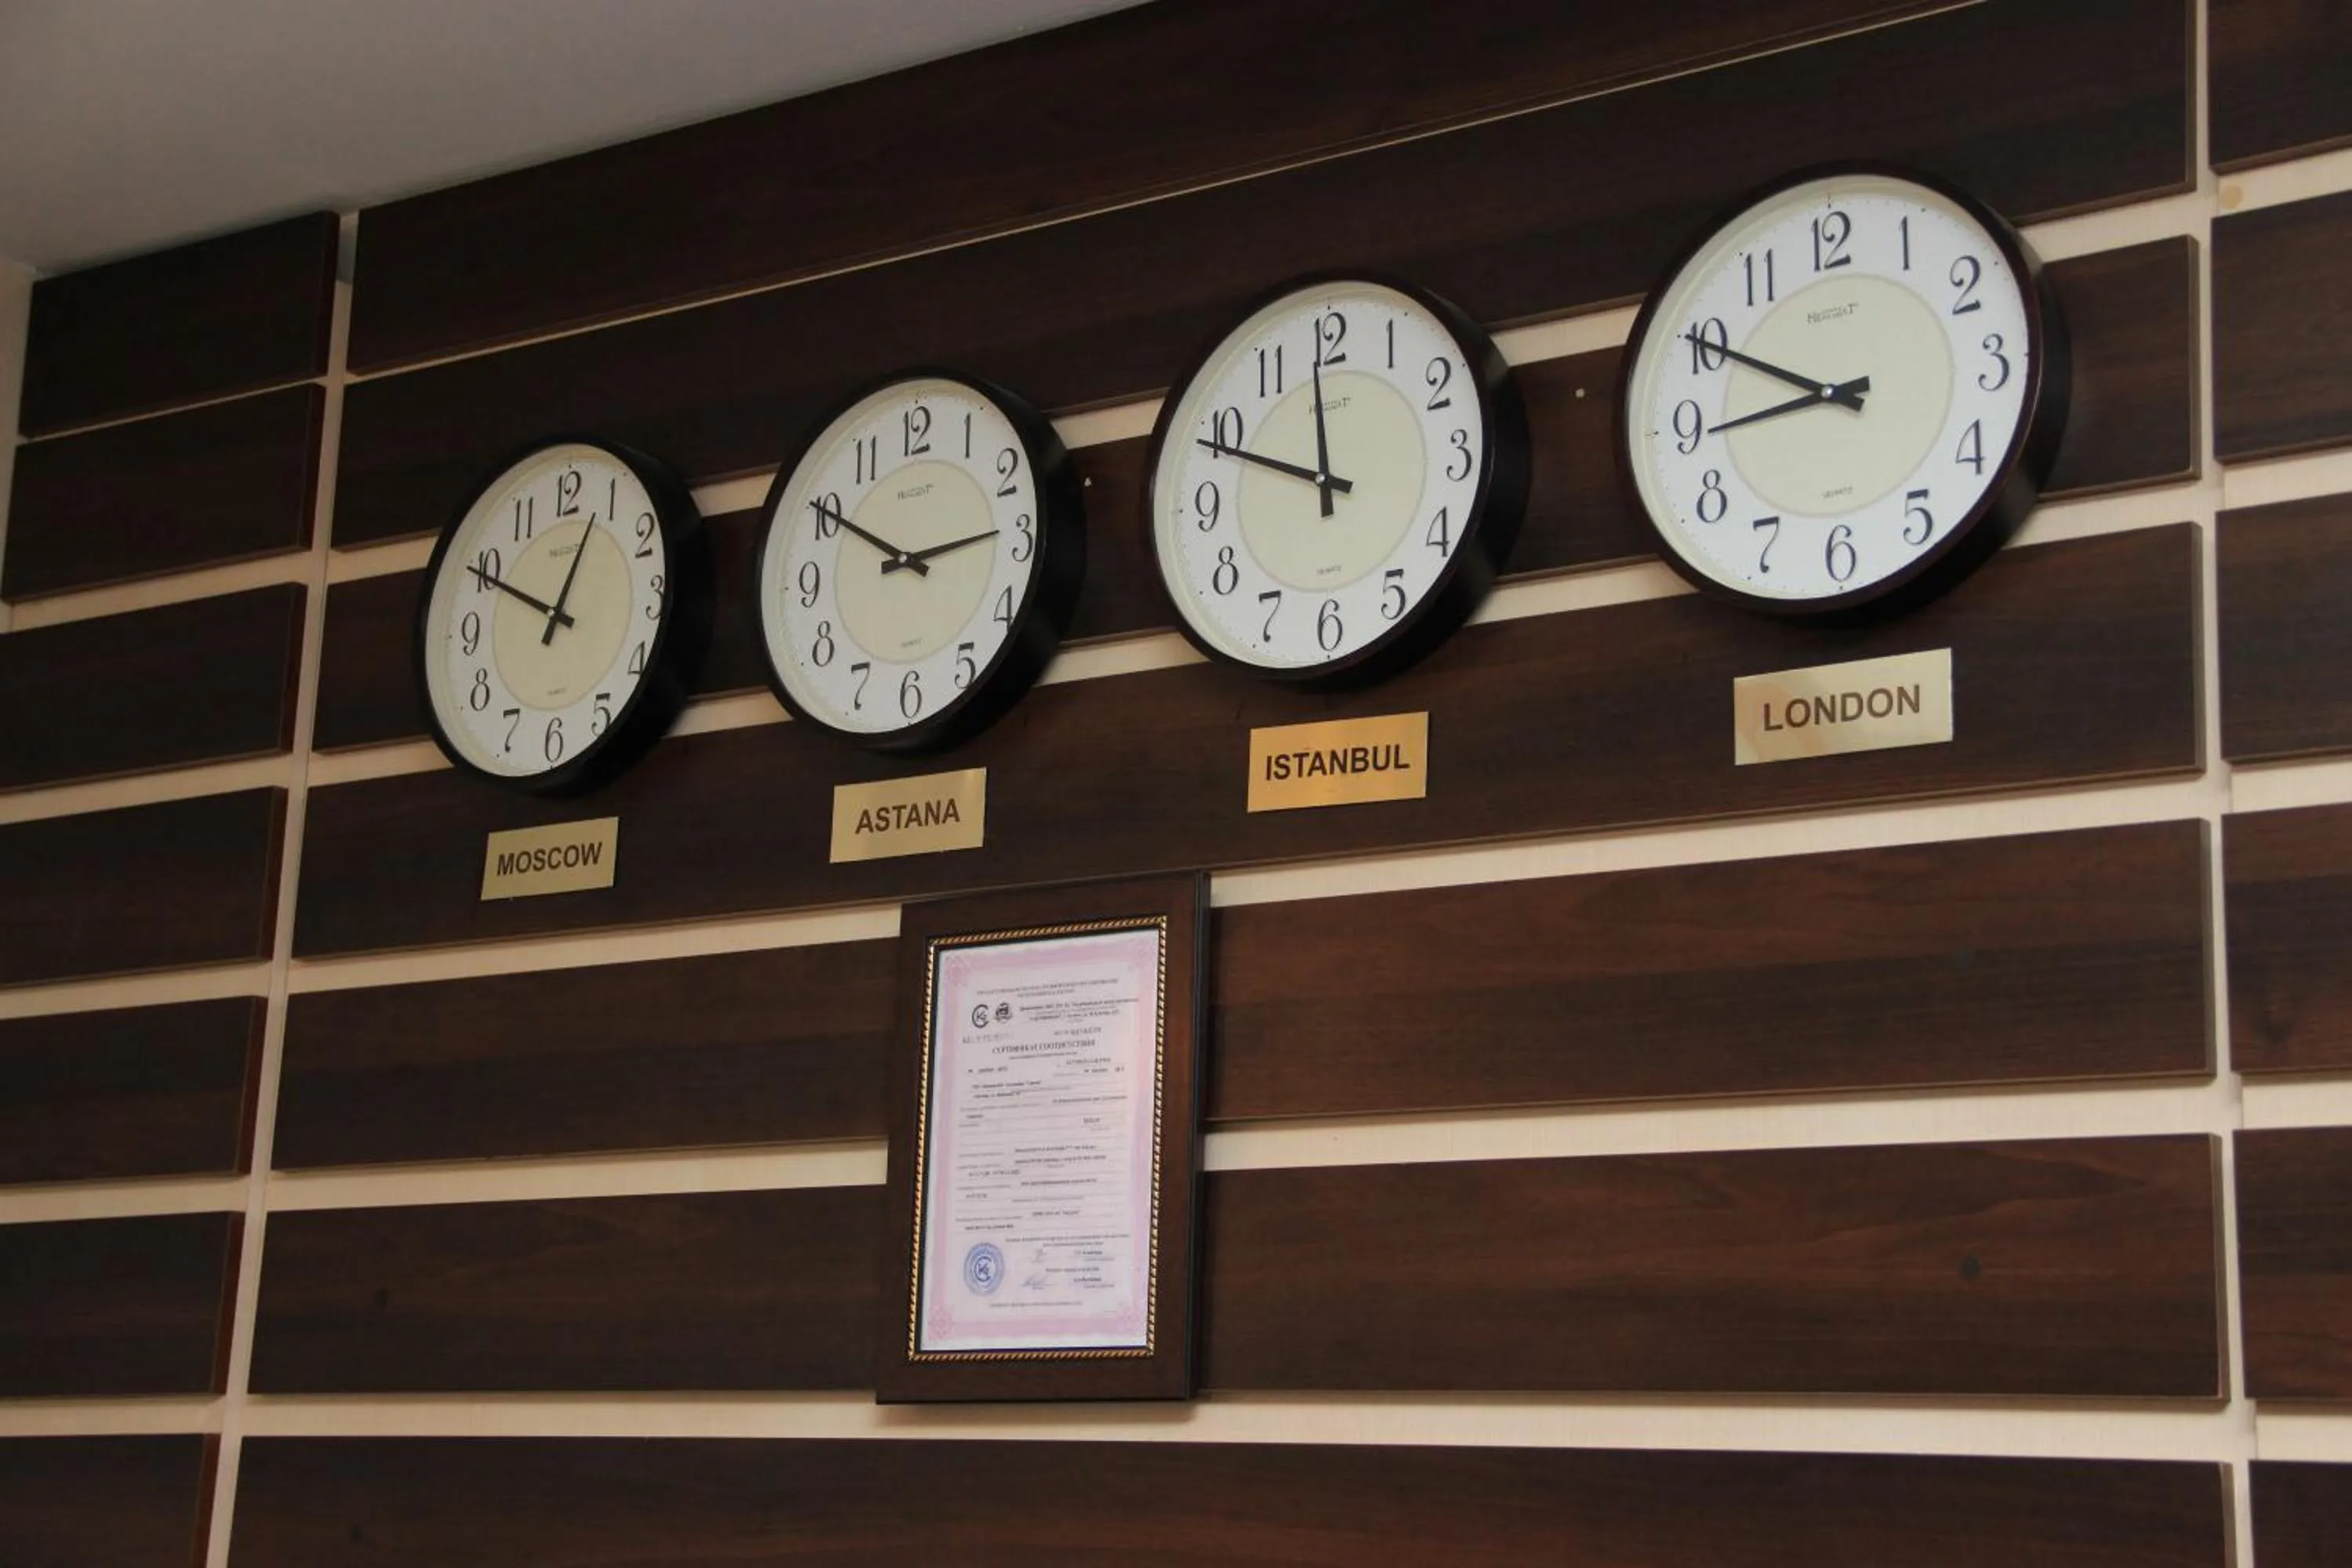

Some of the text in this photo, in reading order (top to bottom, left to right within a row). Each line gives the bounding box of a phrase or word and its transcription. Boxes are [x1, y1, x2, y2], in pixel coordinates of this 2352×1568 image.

[1811, 211, 1851, 272] 12
[1900, 215, 1910, 270] 1
[1744, 249, 1774, 307] 11
[1949, 255, 1981, 315] 2
[1315, 312, 1346, 367] 12
[1386, 318, 1394, 369] 1
[1690, 318, 1726, 375] 10
[1978, 333, 2009, 391] 3
[1258, 345, 1283, 397] 11
[1425, 357, 1451, 410] 2
[903, 405, 931, 457] 12
[964, 412, 971, 458] 1
[1212, 407, 1243, 459] 10
[1672, 399, 1702, 455] 9
[1955, 419, 1985, 475] 4
[855, 435, 877, 485] 11
[996, 447, 1018, 498] 2
[1446, 429, 1472, 482] 3
[514, 496, 534, 541] 11
[556, 471, 582, 517] 12
[608, 477, 615, 521] 1
[815, 492, 841, 540] 10
[1195, 481, 1220, 532] 9
[1696, 470, 1727, 523] 8
[1903, 488, 1933, 545] 5
[635, 512, 655, 558] 2
[1012, 514, 1033, 562] 3
[1425, 506, 1450, 557] 4
[1752, 517, 1780, 573] 7
[1825, 524, 1857, 582] 6
[477, 548, 500, 593] 10
[799, 561, 820, 608] 9
[1212, 546, 1240, 595] 8
[1381, 569, 1406, 619] 5
[645, 575, 664, 620] 3
[993, 585, 1014, 633] 4
[1258, 590, 1282, 642] 7
[462, 612, 480, 655] 9
[811, 620, 834, 666] 8
[1317, 599, 1343, 652] 6
[627, 641, 647, 676] 4
[954, 642, 976, 689] 5
[470, 668, 490, 711] 8
[851, 662, 870, 710] 7
[899, 670, 922, 718] 6
[1764, 684, 1921, 731] LONDON
[503, 708, 520, 753] 7
[591, 692, 612, 735] 5
[544, 717, 564, 762] 6
[1266, 744, 1410, 781] ISTANBUL
[855, 798, 960, 834] ASTANA
[497, 841, 602, 876] MOSCOW
